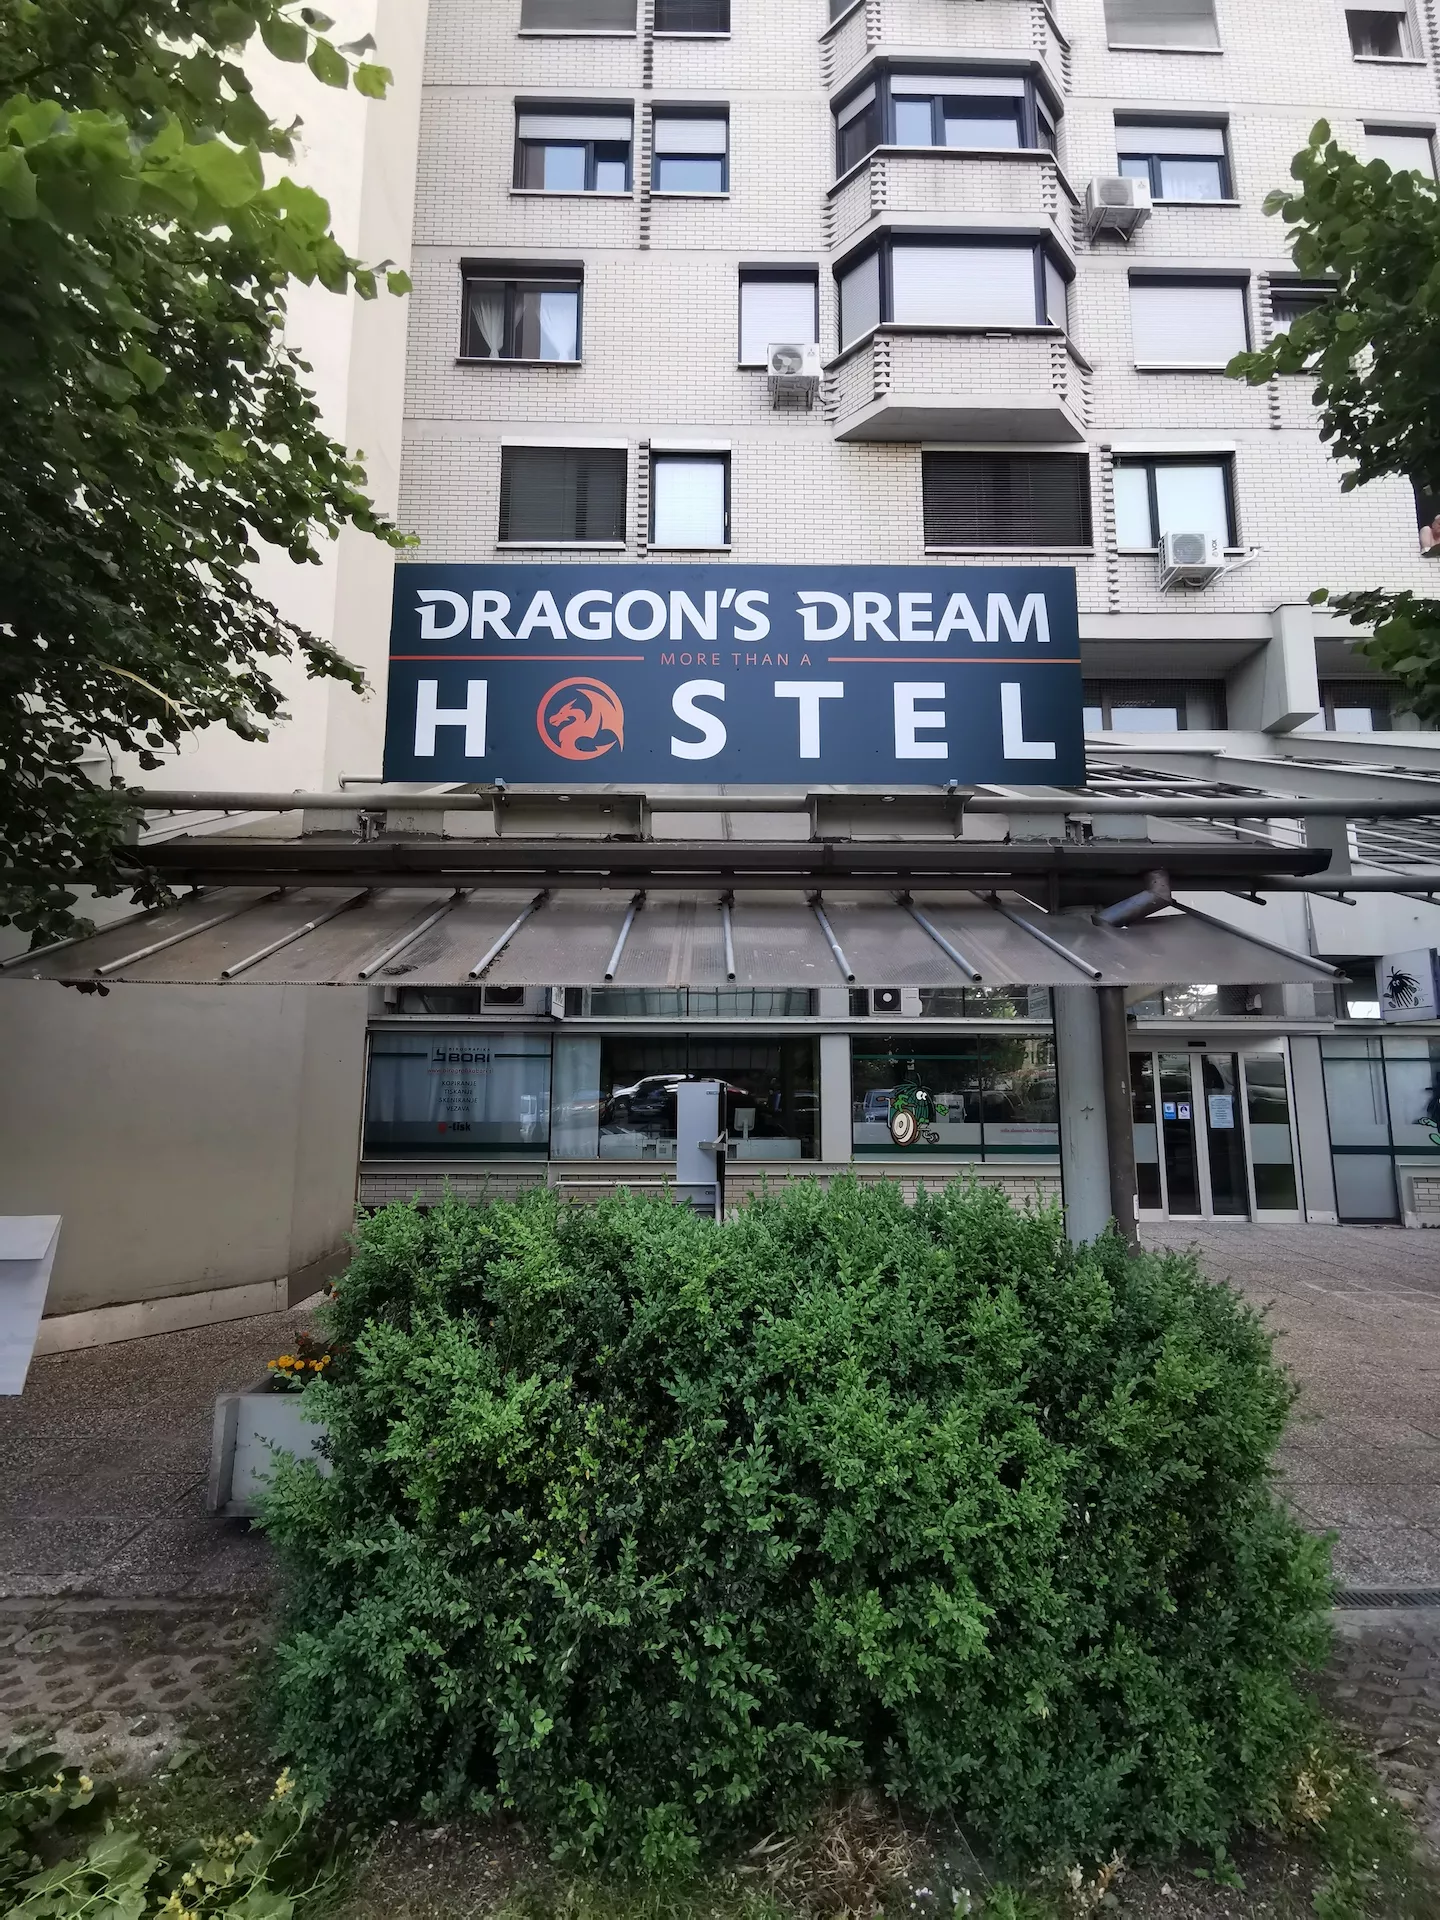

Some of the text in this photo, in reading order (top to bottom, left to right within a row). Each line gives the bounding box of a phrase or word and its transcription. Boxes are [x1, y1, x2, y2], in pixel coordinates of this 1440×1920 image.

[413, 588, 1051, 644] DRAGON'S DREAM
[660, 652, 812, 666] MORE THAN A
[449, 1053, 490, 1062] BORI
